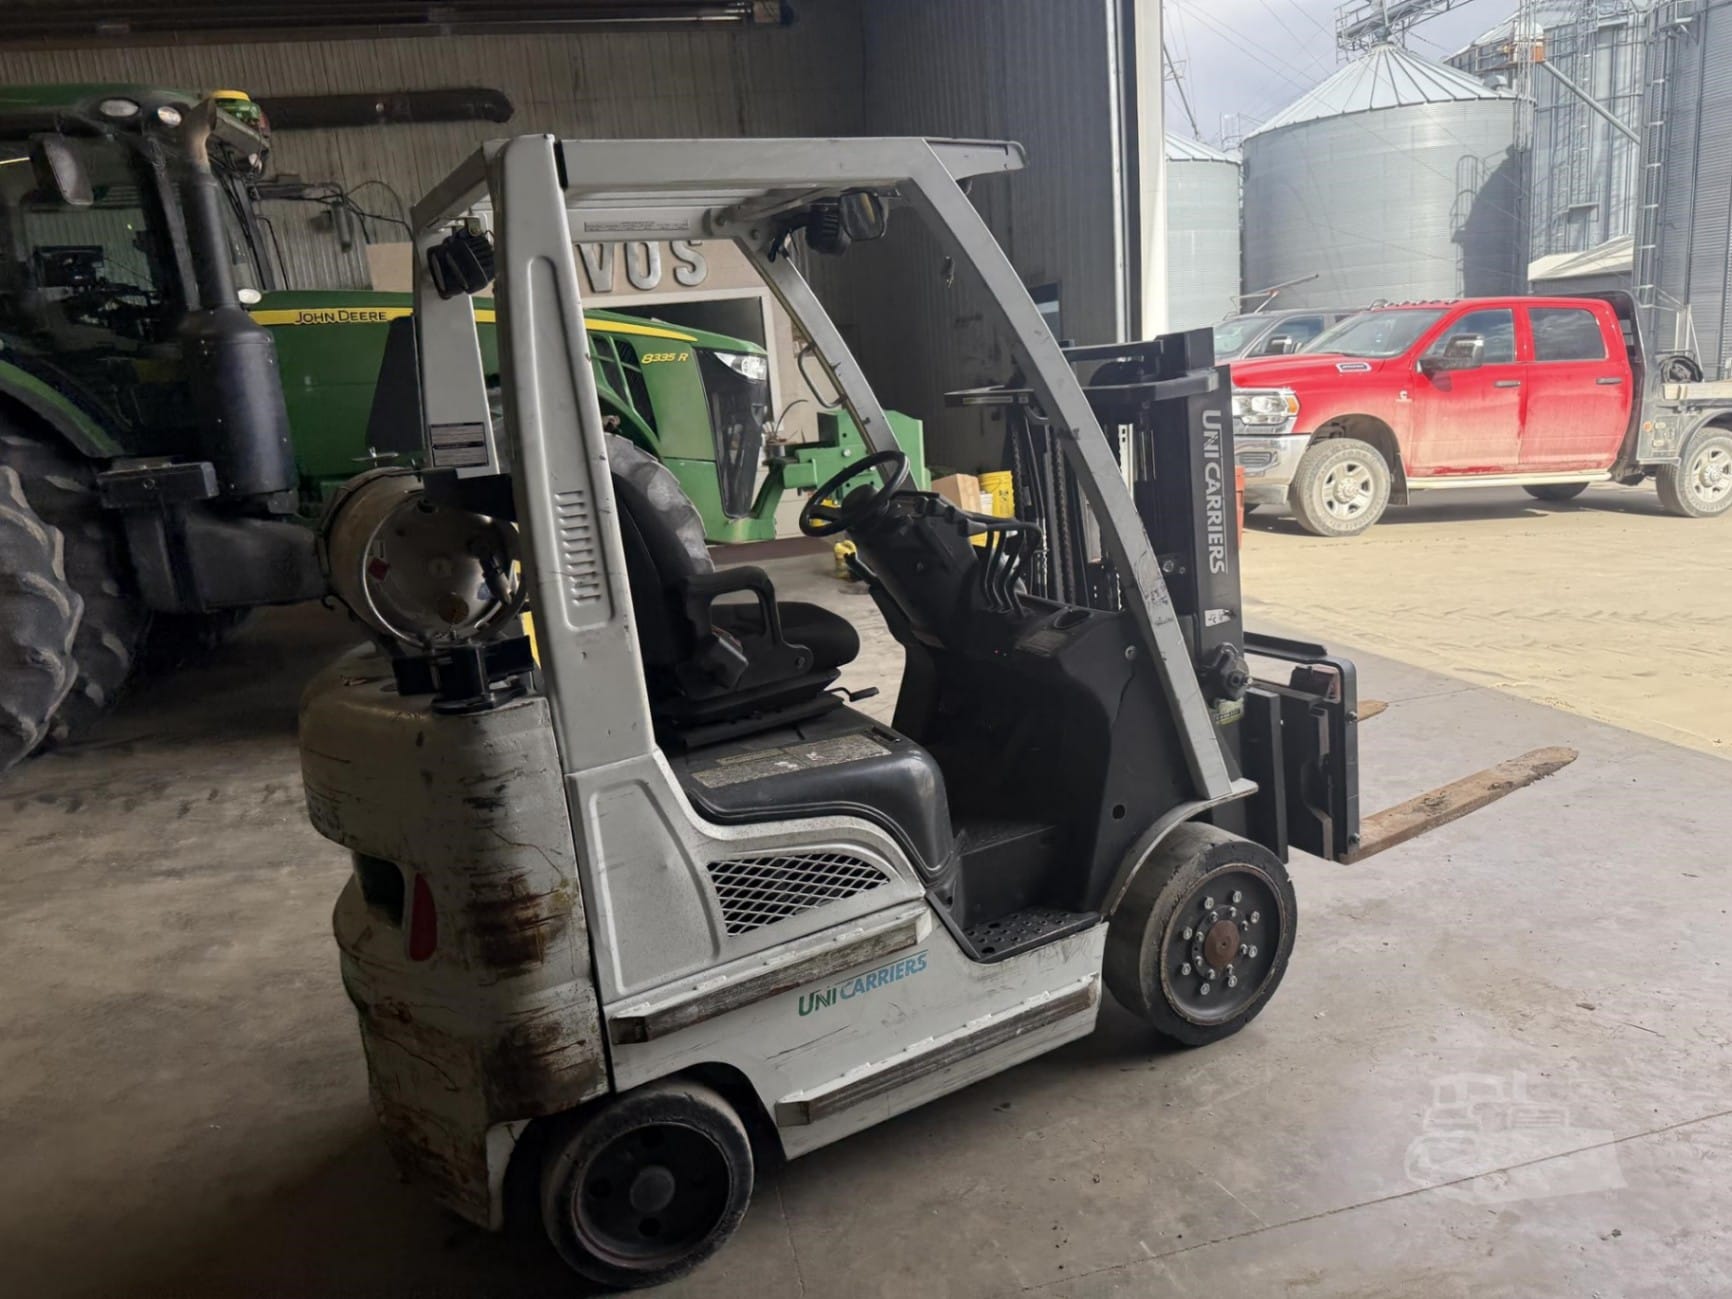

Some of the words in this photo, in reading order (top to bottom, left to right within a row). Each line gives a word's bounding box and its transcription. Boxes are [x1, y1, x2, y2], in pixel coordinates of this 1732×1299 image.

[295, 311, 335, 323] JOHN
[338, 310, 387, 322] DEERE
[641, 353, 676, 364] 8335
[1202, 410, 1227, 575] UNICARRIERS
[798, 952, 928, 1016] UNICARRIERS
